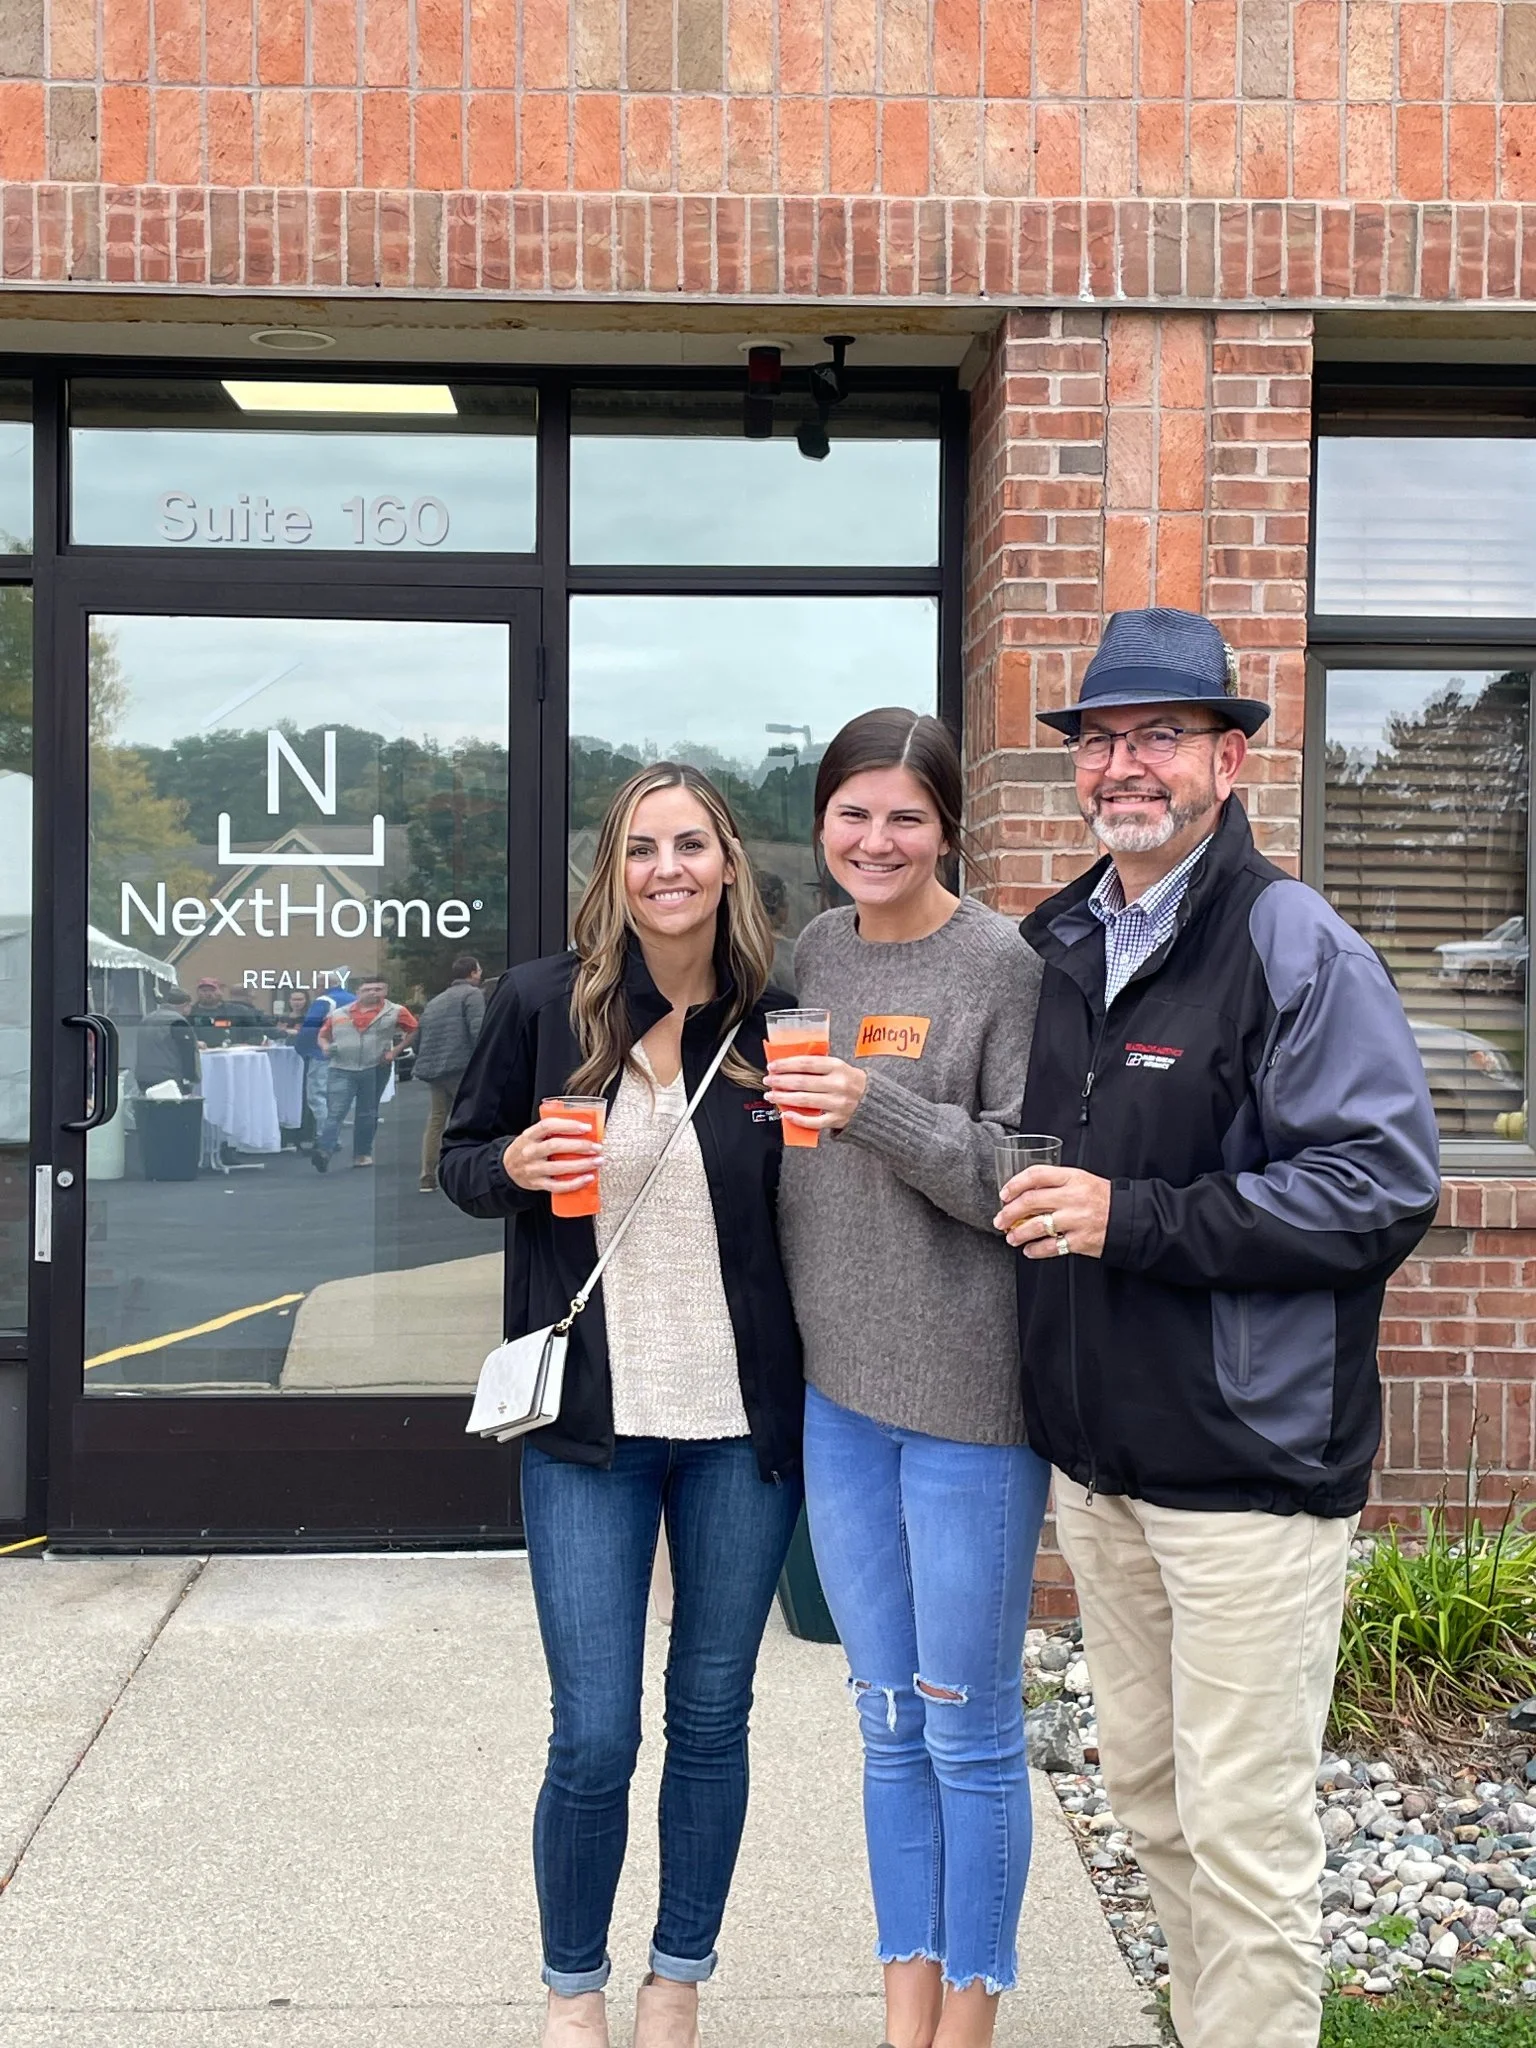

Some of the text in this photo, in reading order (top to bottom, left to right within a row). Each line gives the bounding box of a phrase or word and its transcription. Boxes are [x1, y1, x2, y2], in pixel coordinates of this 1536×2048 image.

[159, 492, 450, 546] Suite 160
[267, 730, 337, 815] N
[242, 970, 351, 990] REALITY
